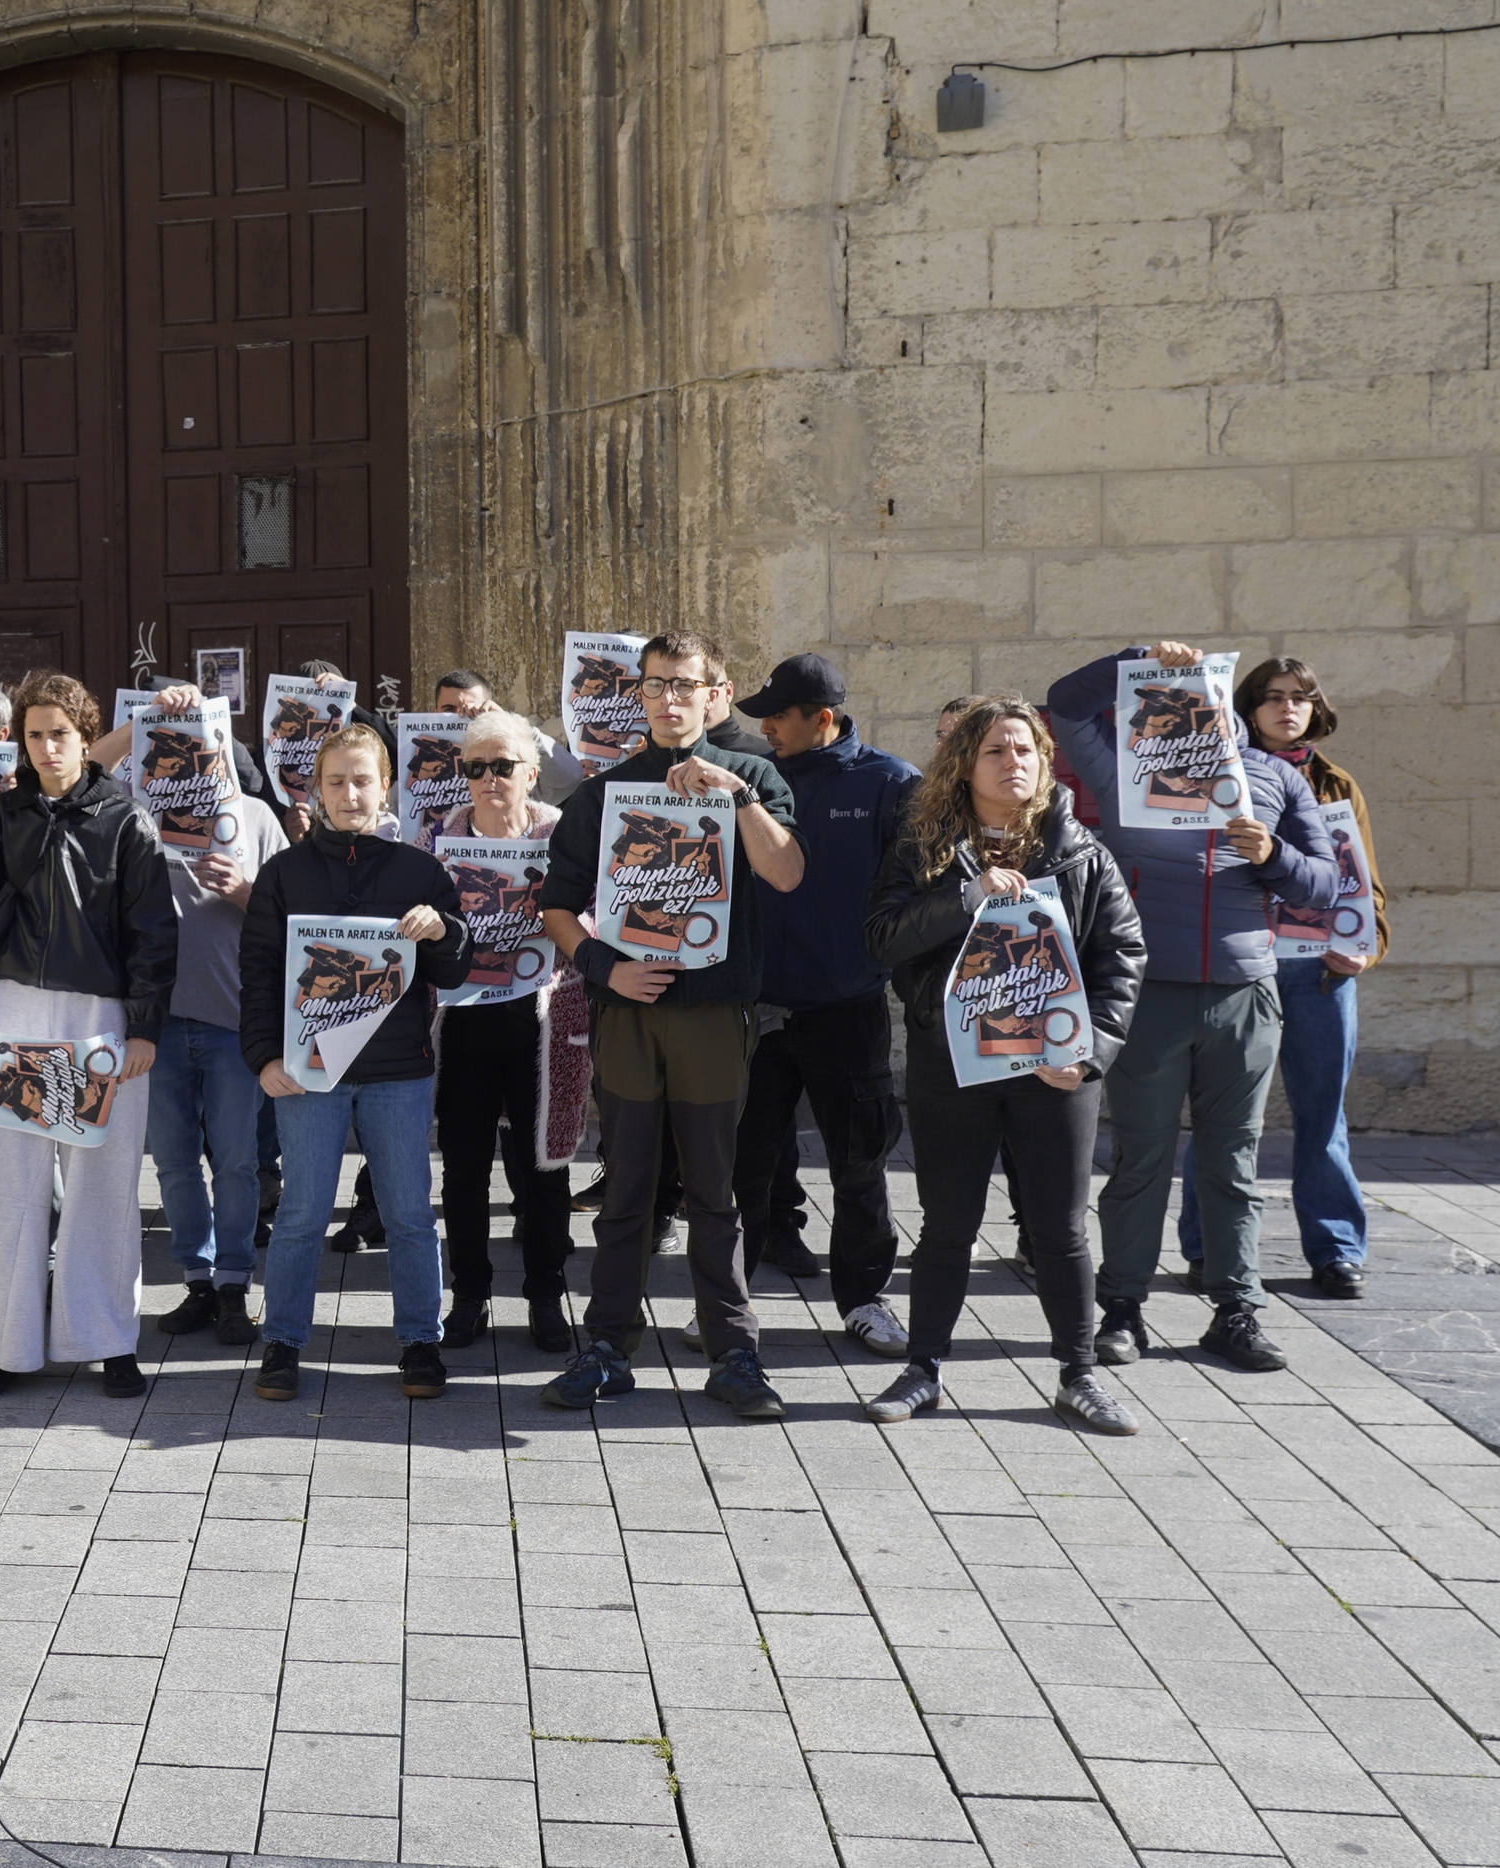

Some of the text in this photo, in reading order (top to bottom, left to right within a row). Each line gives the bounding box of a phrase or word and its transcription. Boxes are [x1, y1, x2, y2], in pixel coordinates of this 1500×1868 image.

[573, 642, 596, 650] MALEN
[598, 644, 609, 652] ETA
[611, 644, 633, 653] ARATZ
[1128, 671, 1157, 681] MALEN
[1160, 669, 1176, 678] ETA
[275, 685, 293, 693] MALEN
[306, 688, 324, 696] ARATZ
[325, 690, 351, 699] ASKATU
[572, 692, 635, 710] Muntai
[142, 714, 166, 725] MALEN
[407, 723, 430, 731] MALEN
[608, 719, 633, 732] ez!
[271, 736, 324, 752] Muntai
[1134, 728, 1220, 757] Muntai
[271, 750, 317, 773] polizia
[298, 764, 314, 775] ez
[1187, 761, 1218, 779] ez!
[146, 768, 219, 796] Muntai
[411, 773, 468, 795] Munta
[149, 778, 235, 817] polizialik
[410, 788, 472, 818] polizia
[615, 795, 644, 805] MALEN
[646, 796, 661, 806] ETA
[695, 797, 730, 809] ASKATU
[192, 800, 220, 817] ez!
[444, 848, 471, 858] MALEN
[473, 849, 488, 858] ETA
[491, 850, 517, 859] ARATZ
[614, 860, 698, 885] Muntai
[610, 876, 720, 915] polizialik
[662, 897, 695, 914] ez!
[298, 928, 327, 938] MALEN
[329, 928, 344, 939] ETA
[347, 929, 375, 940] ARATZ
[472, 918, 544, 944] lizialik
[494, 937, 523, 952] ez!
[957, 958, 1041, 1000] Muntai
[301, 988, 381, 1017] Muntai
[489, 989, 514, 998] ASKE
[961, 969, 1069, 1031] polizialik
[1015, 994, 1046, 1017] ez!
[1022, 1058, 1049, 1068] ASKE
[70, 1066, 87, 1089] ez!
[36, 1060, 59, 1126] Muntai
[48, 1047, 85, 1134] polizialik
